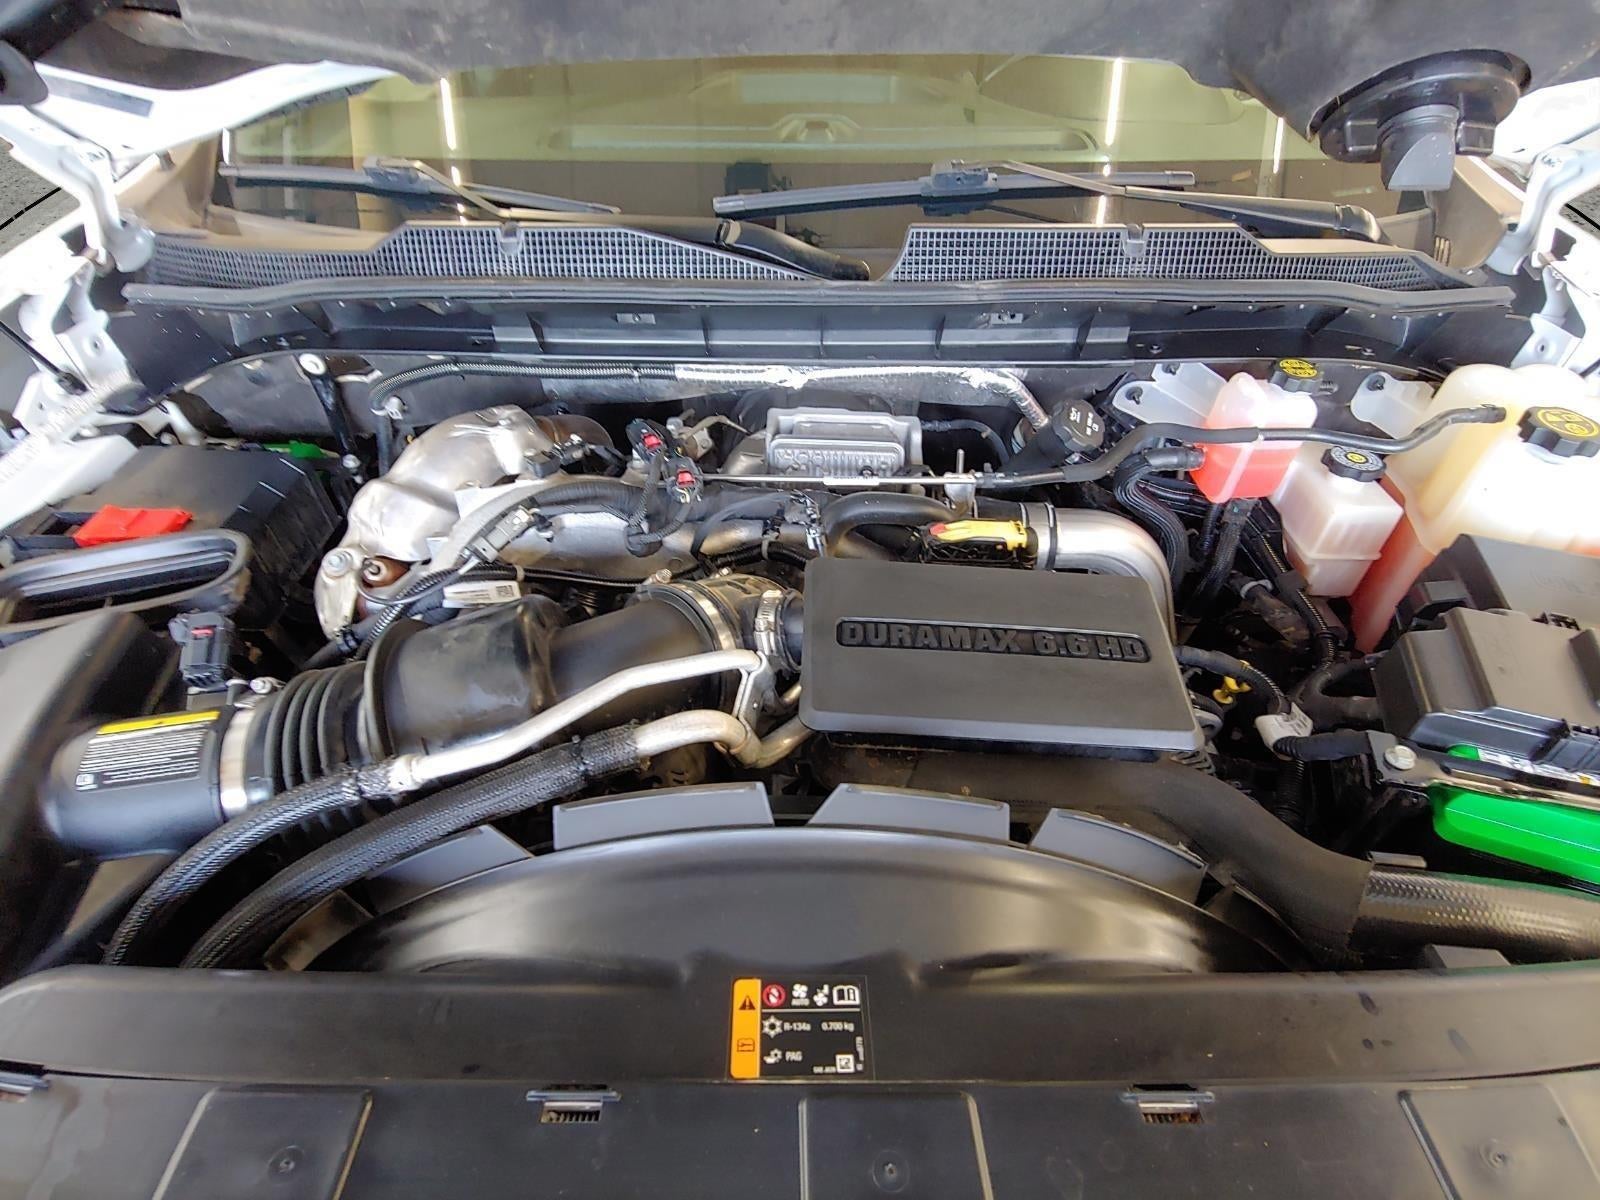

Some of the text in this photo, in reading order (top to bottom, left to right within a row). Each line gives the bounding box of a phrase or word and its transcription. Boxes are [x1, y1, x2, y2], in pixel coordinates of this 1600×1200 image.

[842, 622, 1147, 660] DURAMAX 6.6 HD
[783, 1021, 811, 1031] R-134a
[844, 1021, 854, 1032] kg
[785, 1051, 803, 1061] PAG
